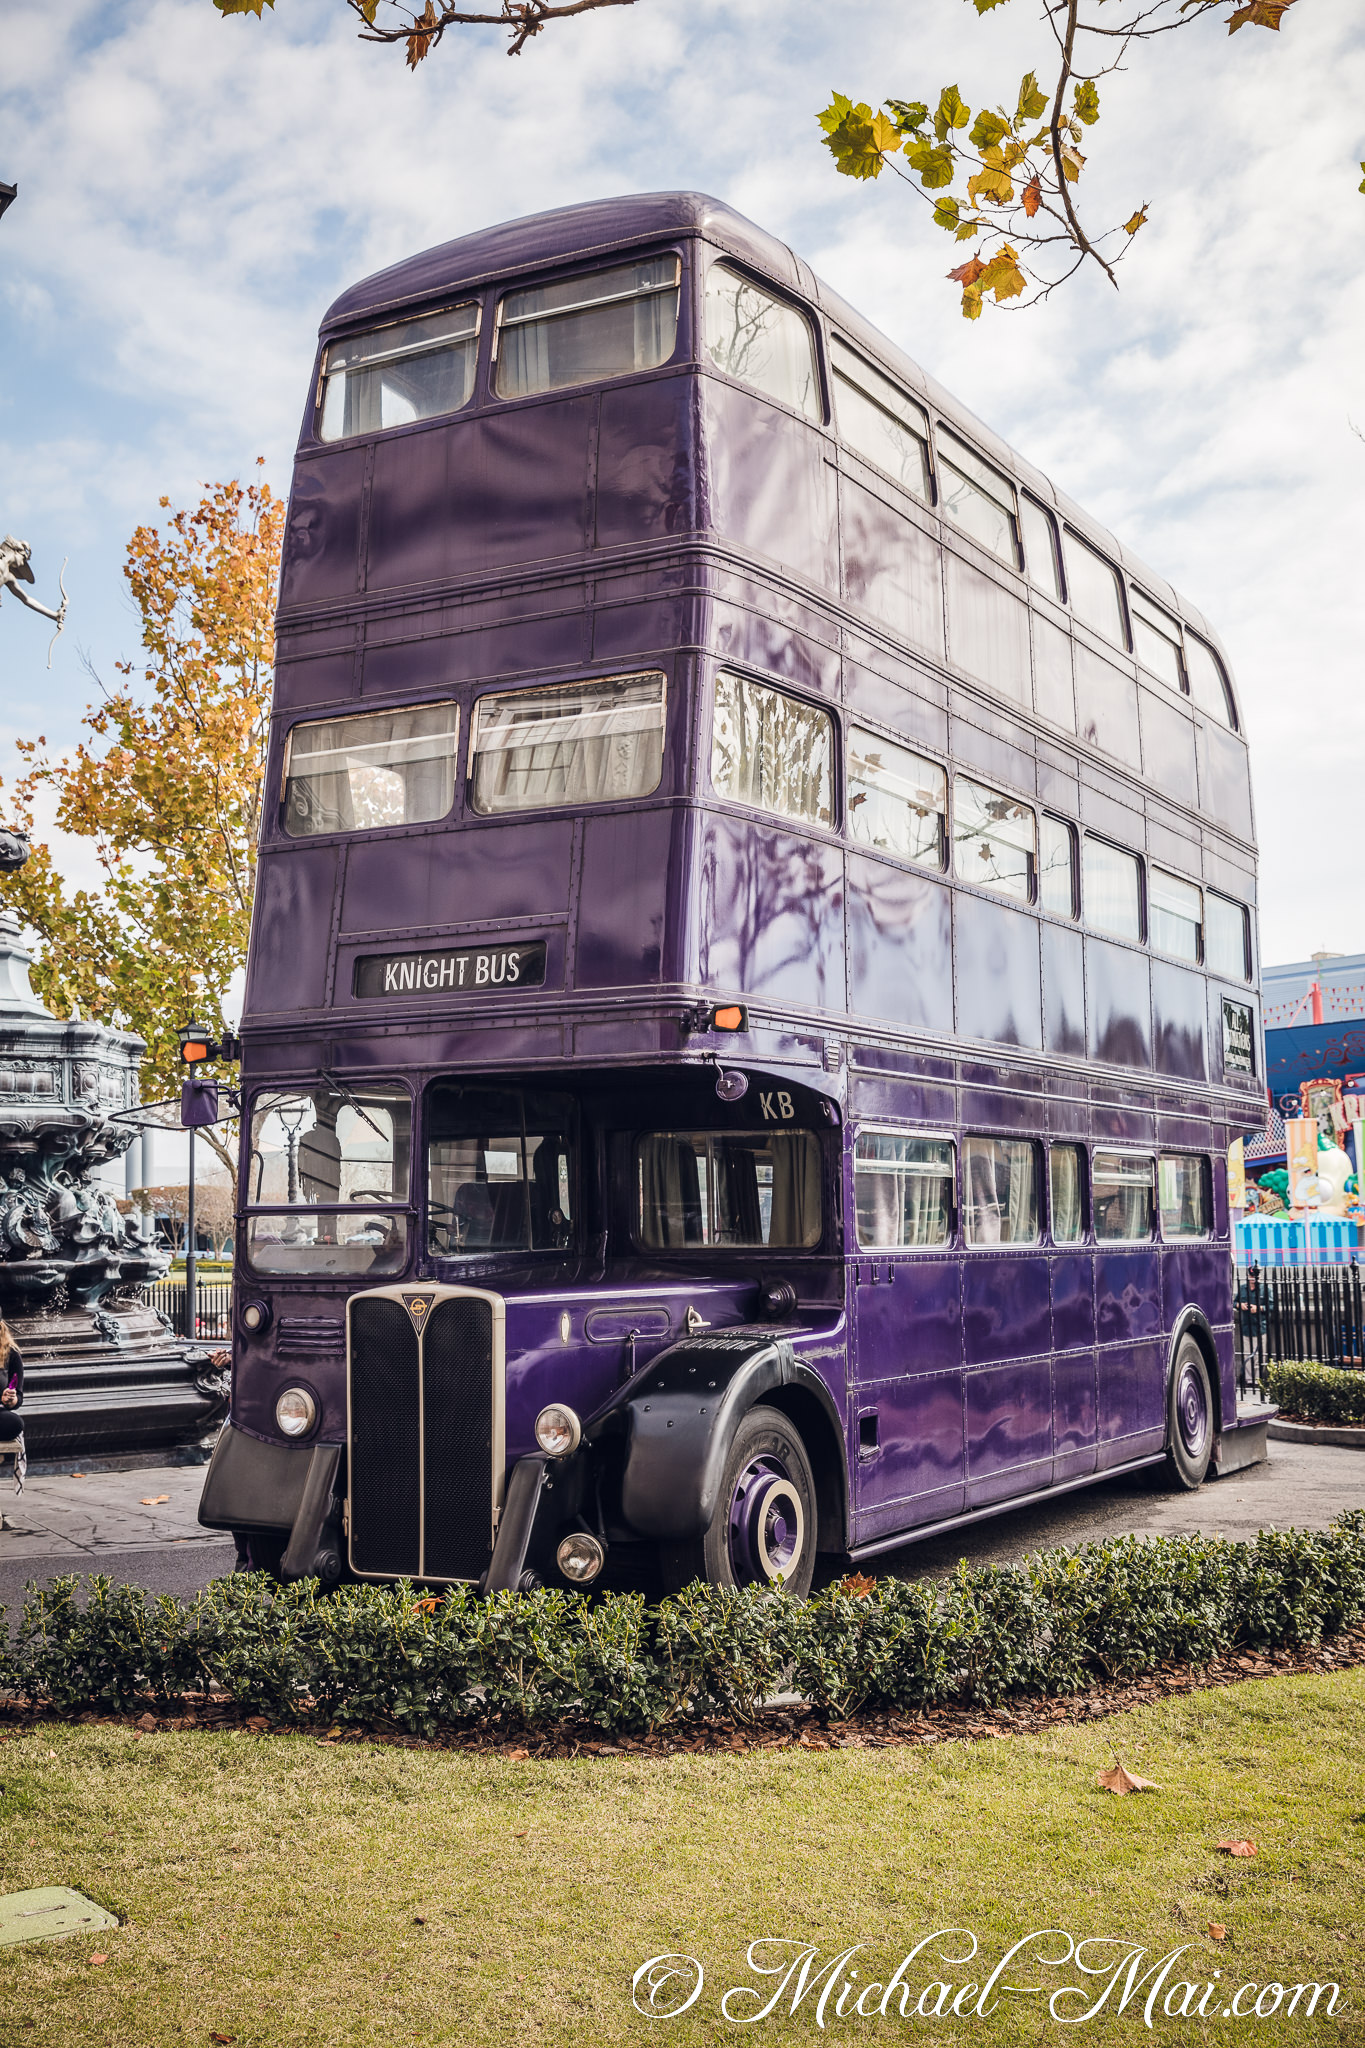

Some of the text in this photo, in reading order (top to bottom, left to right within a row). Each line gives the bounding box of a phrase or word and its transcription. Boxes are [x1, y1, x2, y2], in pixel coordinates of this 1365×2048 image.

[384, 952, 520, 991] KNIGHT BUS
[759, 1091, 795, 1120] KB
